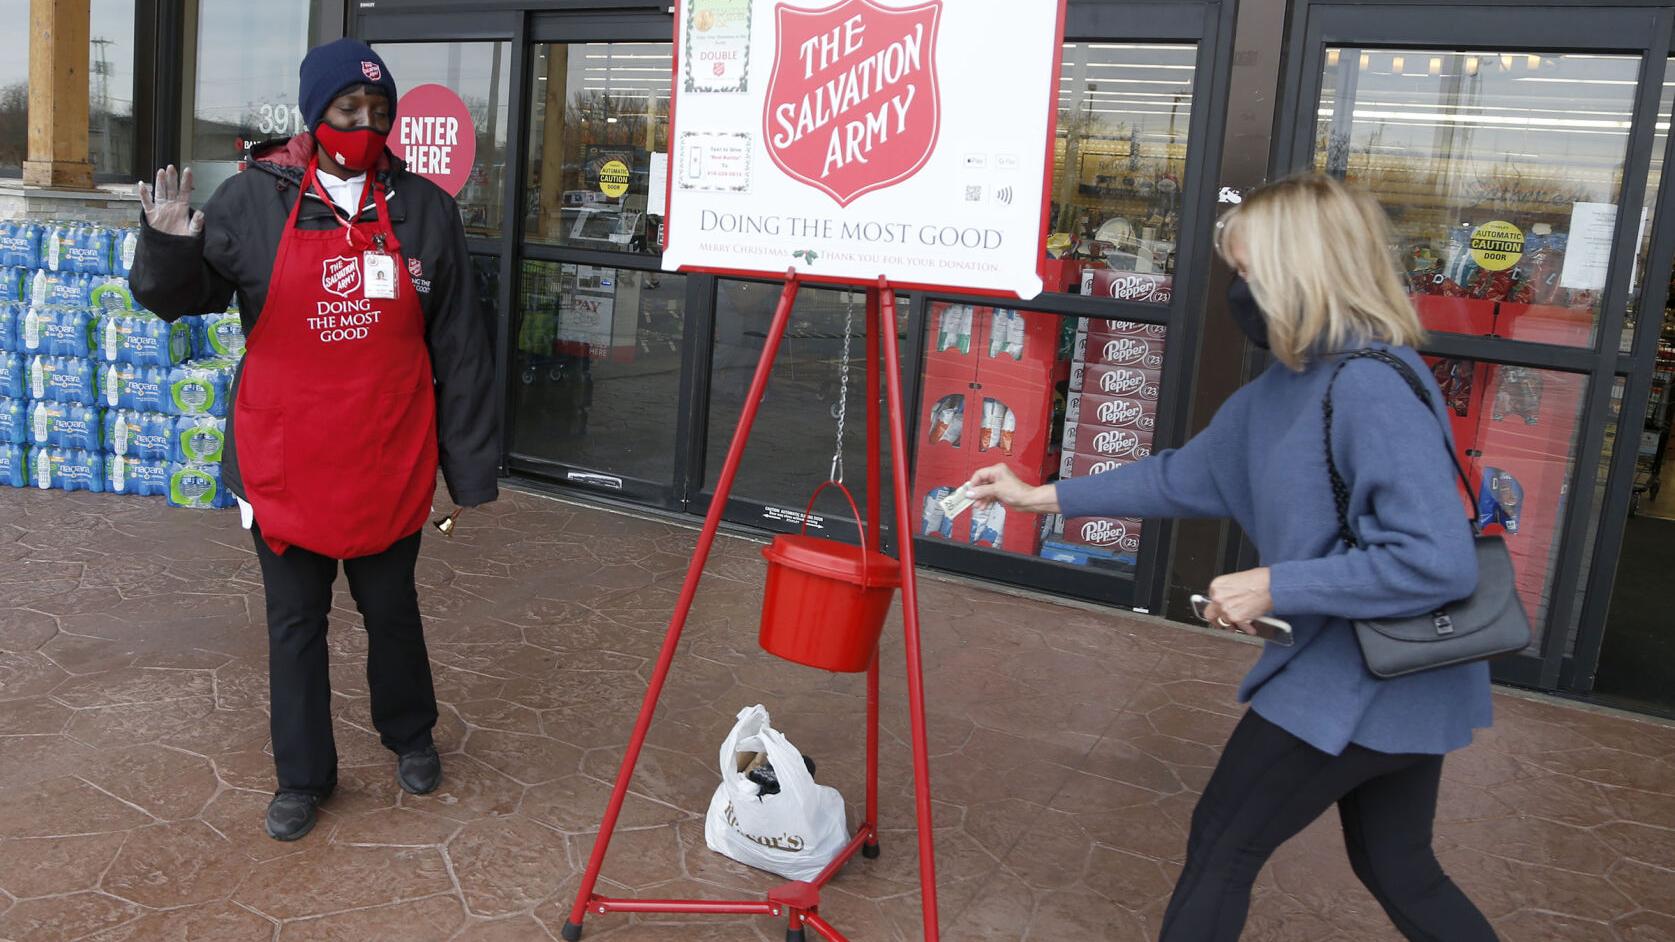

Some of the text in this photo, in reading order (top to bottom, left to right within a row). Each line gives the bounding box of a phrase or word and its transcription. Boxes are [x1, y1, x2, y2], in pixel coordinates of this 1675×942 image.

[700, 50, 738, 61] DOUBLE
[800, 14, 866, 80] THE
[774, 23, 924, 149] SALVATION
[260, 104, 309, 134] 391
[401, 116, 459, 146] ENTER
[820, 84, 916, 179] ARMY
[405, 146, 452, 175] HERE
[600, 175, 629, 183] CAUTION
[700, 209, 1003, 250] DOING THE MOST GOOD
[1476, 230, 1521, 240] AUTOMATIC
[1471, 239, 1521, 253] CAUTION
[700, 242, 730, 253] MERRY
[733, 244, 789, 257] CHRISTMAS
[820, 250, 855, 261] THANK
[858, 254, 880, 264] YOU
[883, 256, 903, 265] FOR
[906, 257, 936, 268] YOUR
[1483, 252, 1507, 261] DOOR
[325, 261, 356, 288] SALVATION
[330, 260, 343, 274] THE
[337, 272, 355, 291] ARMY
[1112, 278, 1153, 299] Pepper
[1126, 276, 1142, 288] Dr
[317, 299, 371, 316] DOING
[307, 310, 381, 330] THE MOST
[320, 327, 369, 342] GOOD
[1106, 341, 1146, 361] Pepper
[1119, 338, 1136, 350] Dr
[1103, 371, 1142, 392] Pepper
[1116, 369, 1133, 382] Dr
[1147, 386, 1157, 396] 23
[1100, 402, 1139, 423] Pepper
[1113, 400, 1130, 413] Dr
[1143, 418, 1154, 427] 23
[1096, 433, 1136, 454] Pepper
[1109, 430, 1126, 443] Dr
[1140, 447, 1150, 457] 23
[1085, 521, 1122, 542] Pepper
[1099, 520, 1114, 532] Dr
[1127, 537, 1137, 546] 23
